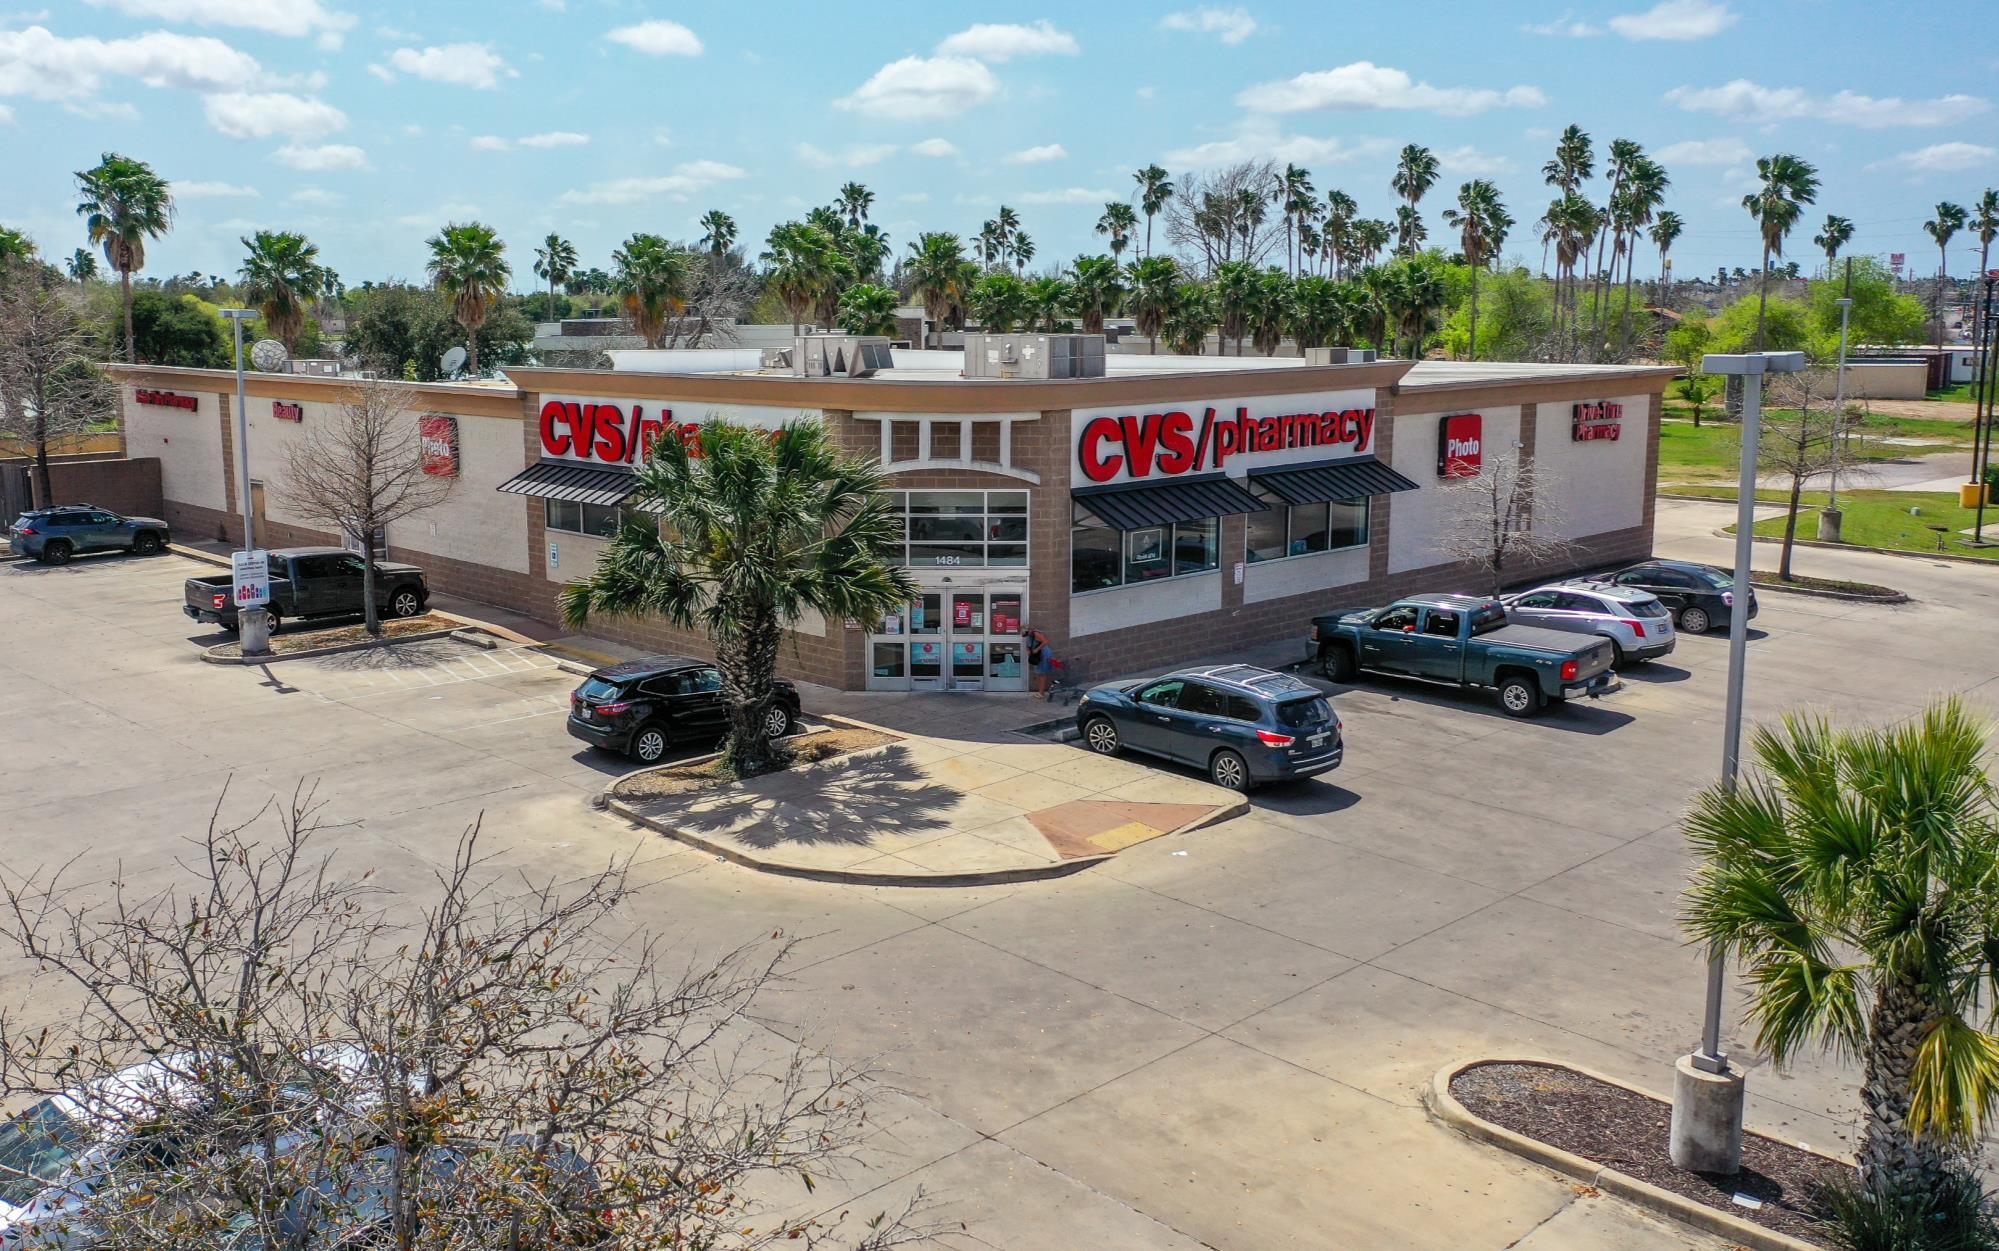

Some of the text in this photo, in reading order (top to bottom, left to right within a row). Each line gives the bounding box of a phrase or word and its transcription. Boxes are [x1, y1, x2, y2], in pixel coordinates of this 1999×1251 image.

[540, 400, 791, 464] CVS/pa
[1573, 423, 1621, 441] Pharmacy
[1078, 407, 1375, 482] CVS/pharmacy
[1447, 437, 1479, 457] Photo
[935, 556, 960, 565] 1484
